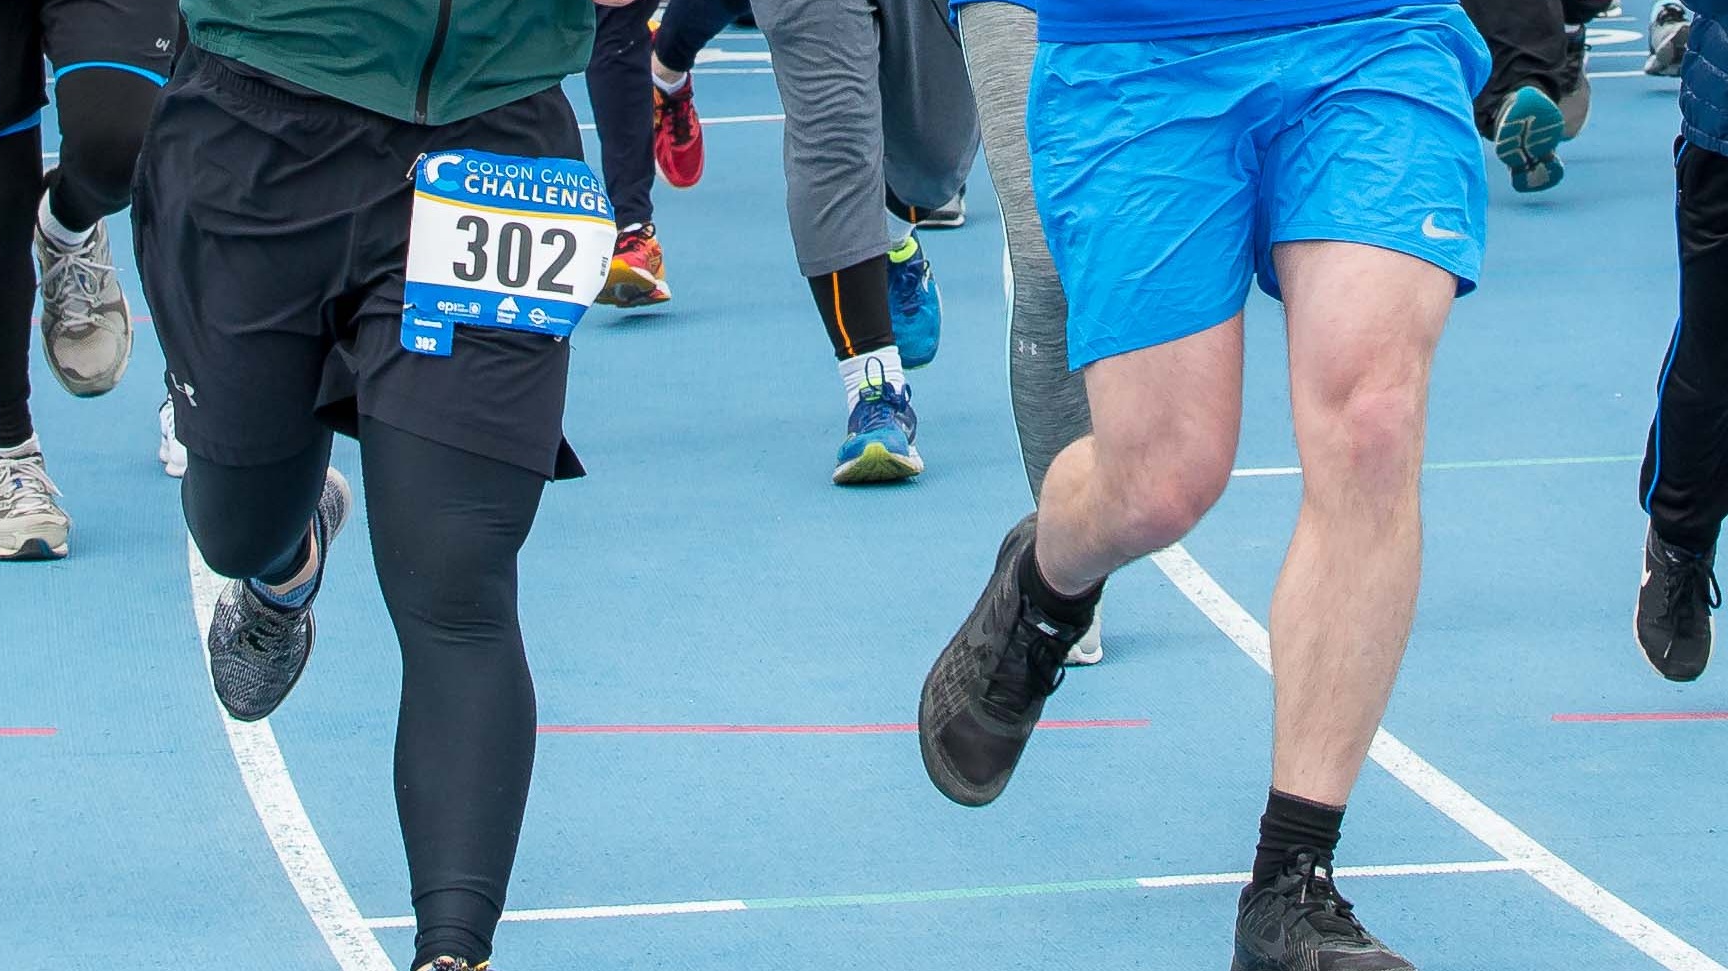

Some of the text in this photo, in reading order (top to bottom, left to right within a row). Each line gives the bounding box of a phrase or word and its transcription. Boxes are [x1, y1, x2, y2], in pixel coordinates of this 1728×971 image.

[464, 174, 609, 215] CHALLENGE
[466, 160, 608, 197] COLON CANCER
[452, 214, 578, 296] 302
